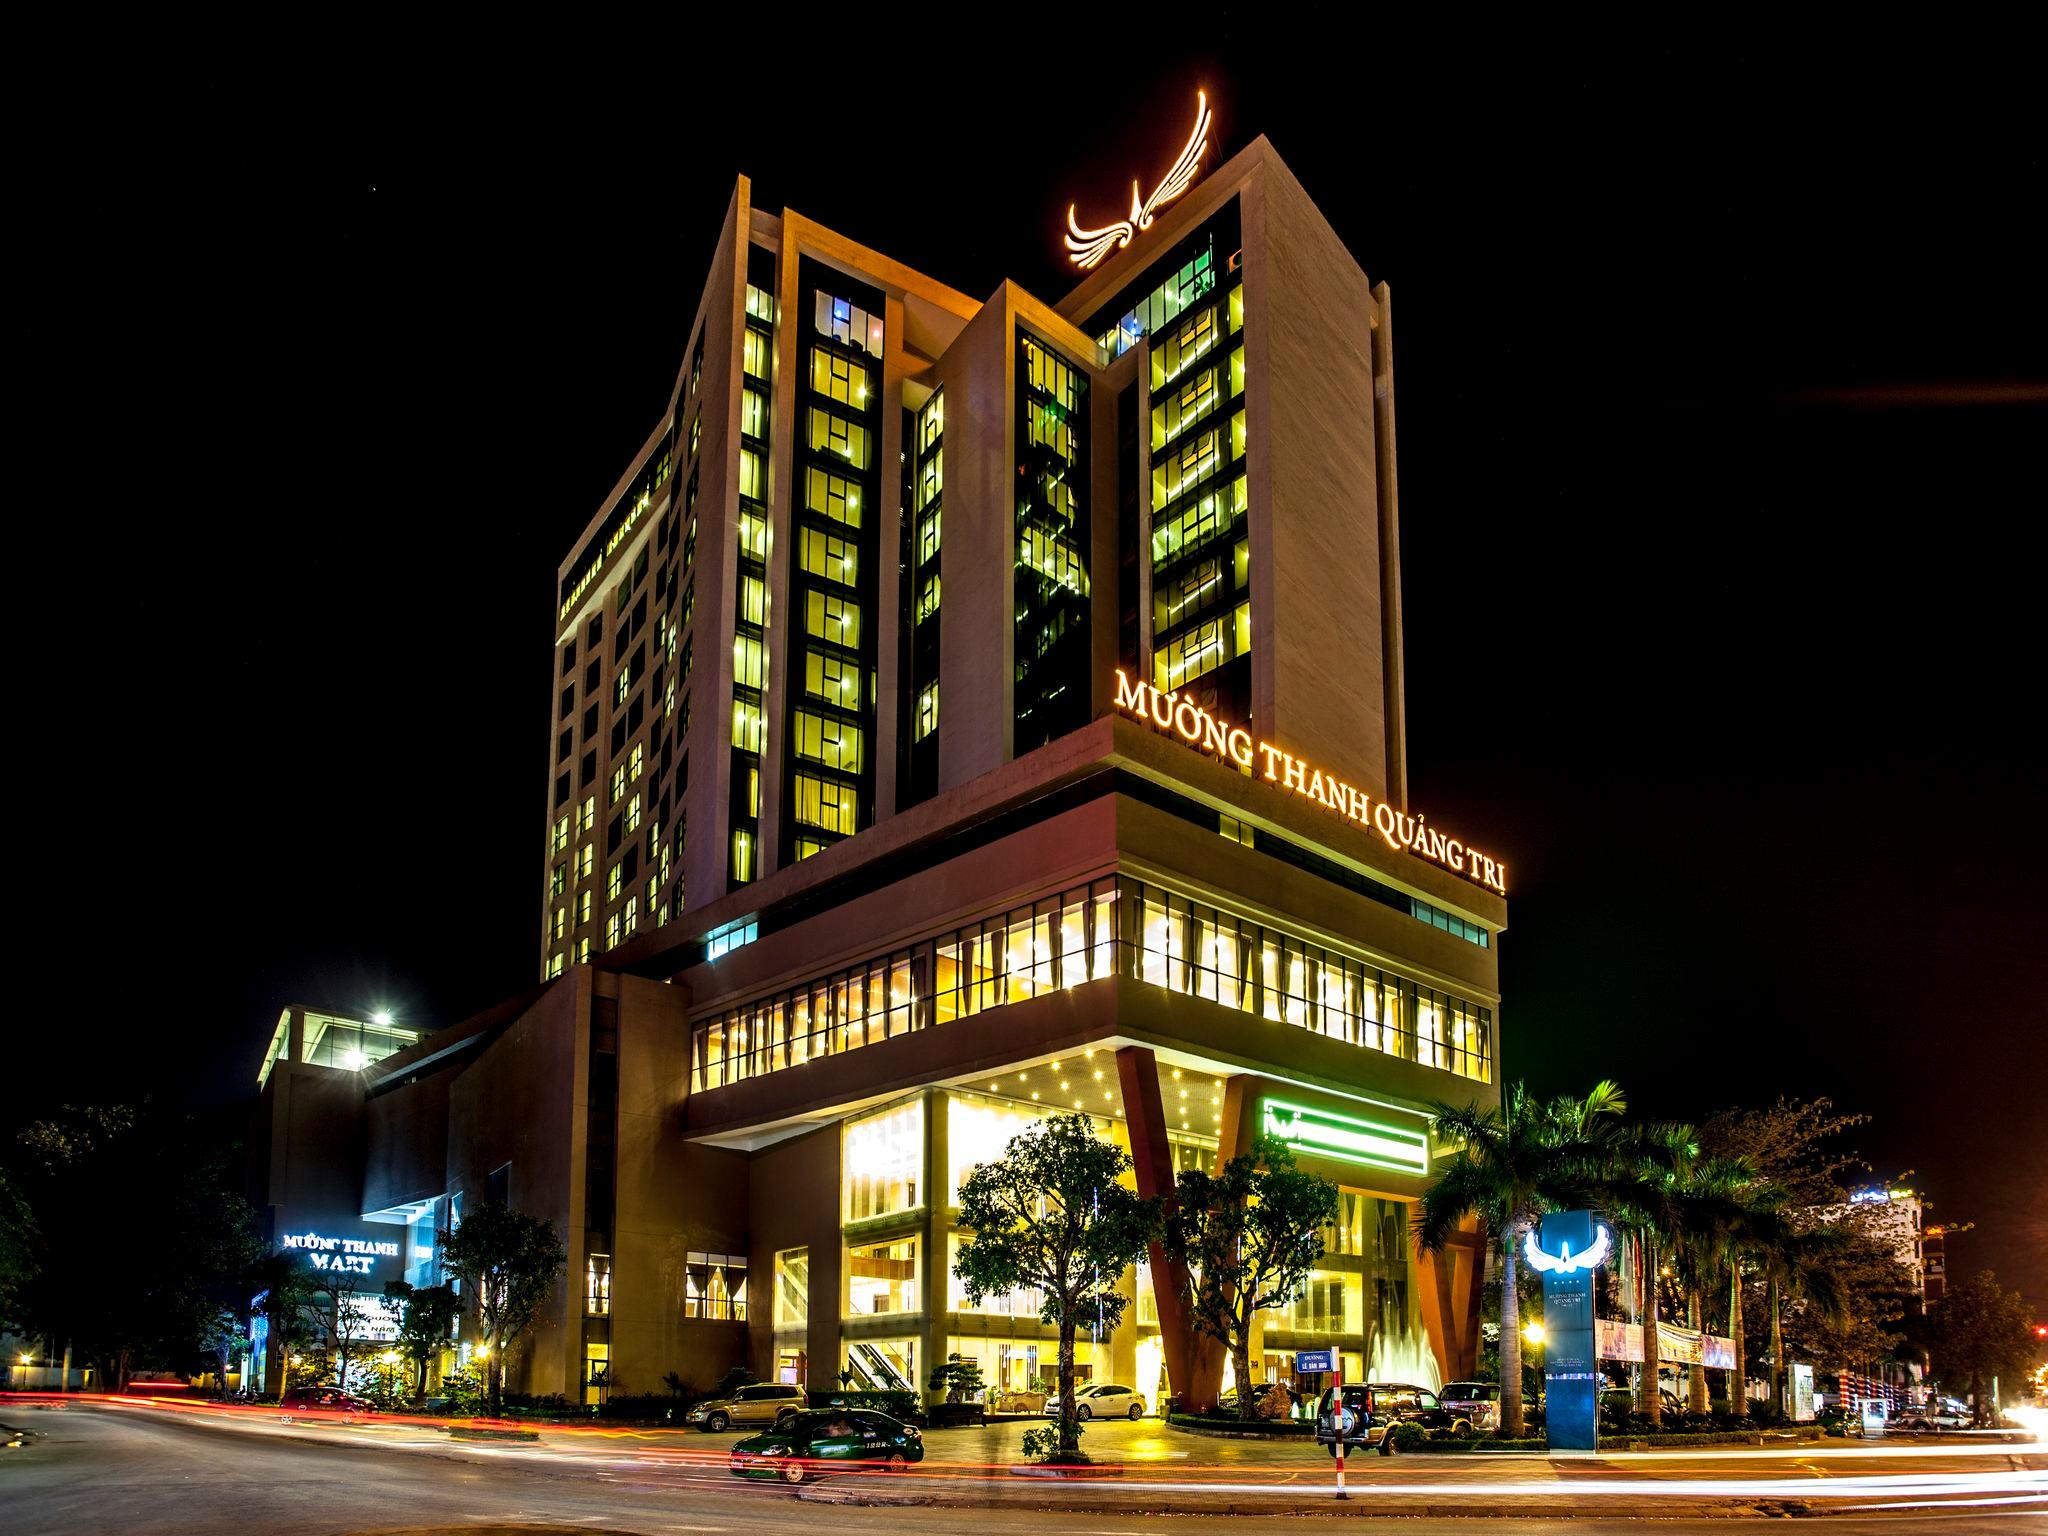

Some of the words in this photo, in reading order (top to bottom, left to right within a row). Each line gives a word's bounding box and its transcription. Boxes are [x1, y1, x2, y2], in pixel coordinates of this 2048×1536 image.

[1113, 669, 1254, 767] MƯỜNG
[1259, 740, 1371, 827] THANH
[1374, 802, 1464, 870] QUẢNG
[1466, 846, 1507, 896] TRỊ
[341, 1239, 399, 1256] THANH
